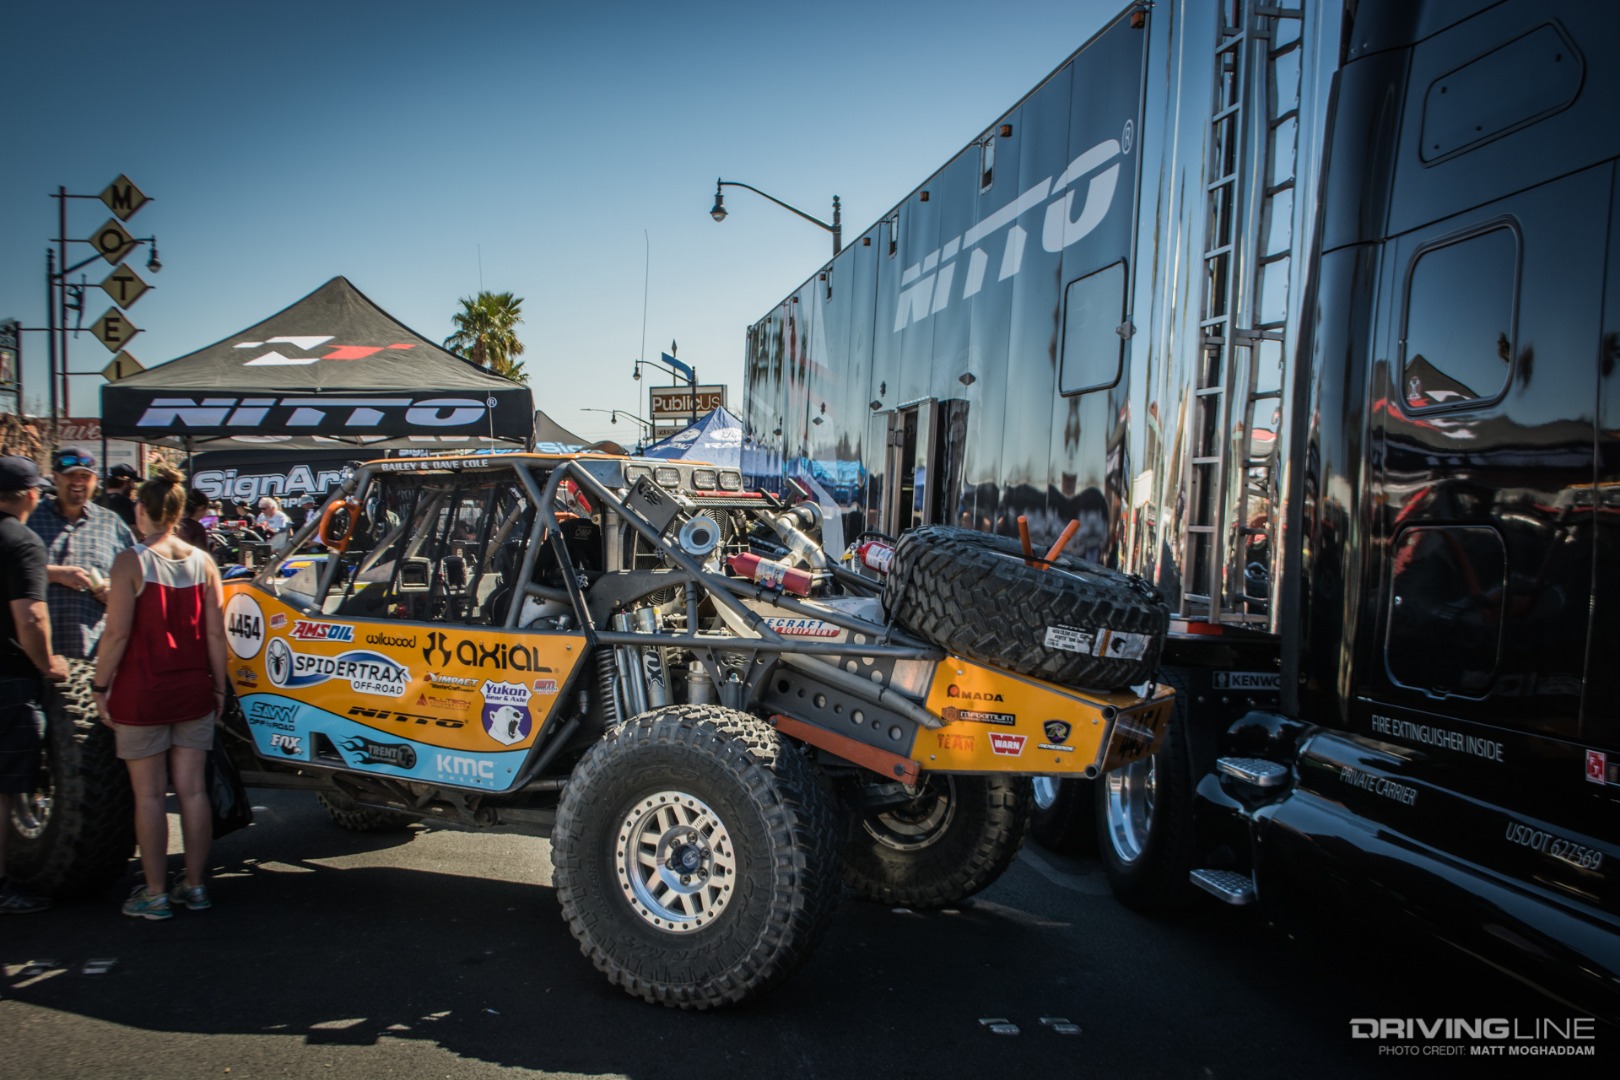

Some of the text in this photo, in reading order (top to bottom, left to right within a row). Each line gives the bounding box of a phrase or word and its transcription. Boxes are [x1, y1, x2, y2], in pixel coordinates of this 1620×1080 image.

[893, 139, 1120, 333] NITTO
[136, 398, 486, 427] NITTO
[381, 459, 489, 471] BAILEY & DAVE COLE
[228, 613, 261, 640] 4454
[293, 621, 353, 640] AMSOIL
[767, 618, 825, 629] ECRAFT
[781, 627, 833, 636] EQUIPMENT
[366, 632, 416, 648] wilwood
[295, 655, 406, 683] SPIDERTRAX
[353, 681, 404, 695] OFF-ROAD
[438, 675, 479, 687] IMPACT
[486, 683, 527, 697] Yukon
[347, 706, 465, 728] NITTO
[270, 733, 302, 750] FOX
[994, 739, 1020, 750] WARN
[1372, 714, 1504, 763] FIRE EXTINGUISHER INSIDE
[368, 744, 397, 757] TRENT
[1340, 765, 1418, 806] PRIVATE CARRIER
[1506, 822, 1602, 871] USDOT 627569
